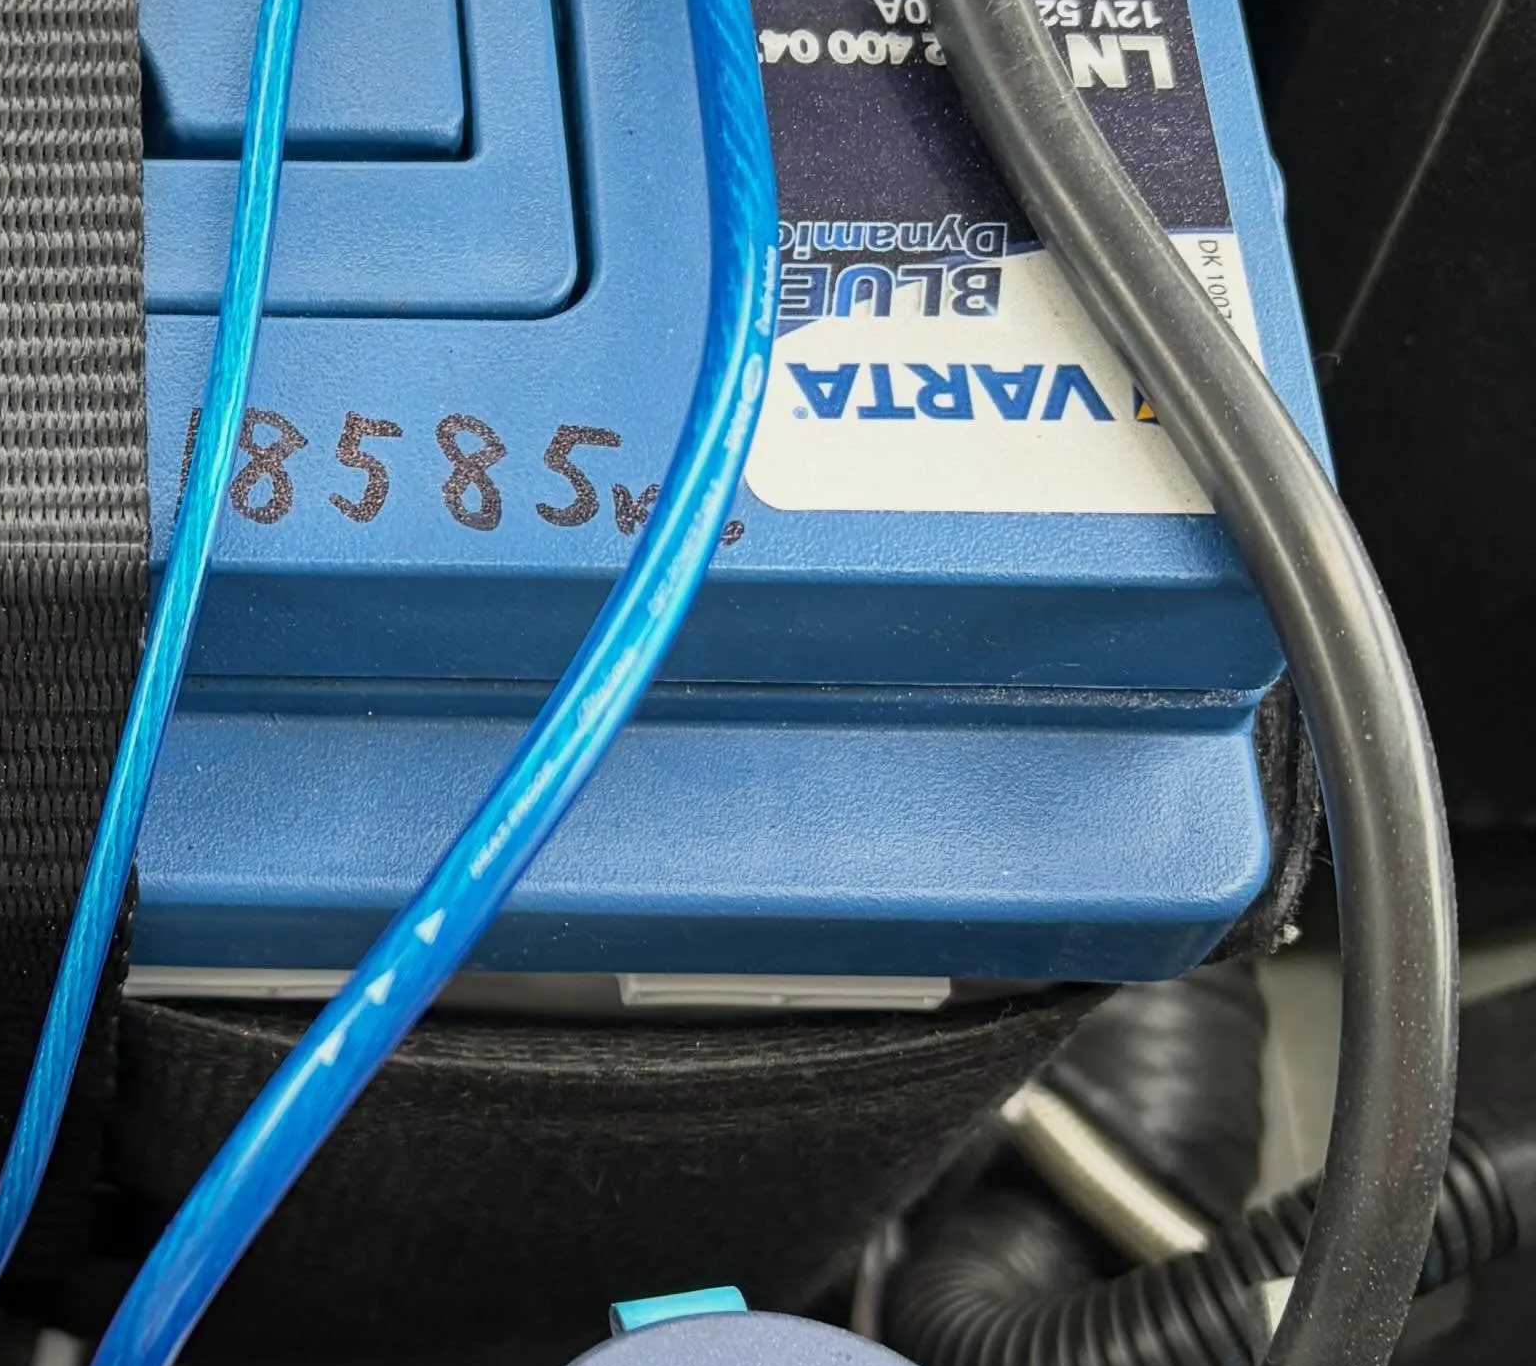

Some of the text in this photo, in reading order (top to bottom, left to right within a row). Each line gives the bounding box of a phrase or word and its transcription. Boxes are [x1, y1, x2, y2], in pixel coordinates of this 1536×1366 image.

[758, 28, 821, 65] 04
[827, 31, 914, 65] 400
[1066, 34, 1176, 89] LN
[1197, 238, 1224, 267] DK
[777, 262, 1003, 319] BLUE
[785, 361, 1117, 422] VARTA
